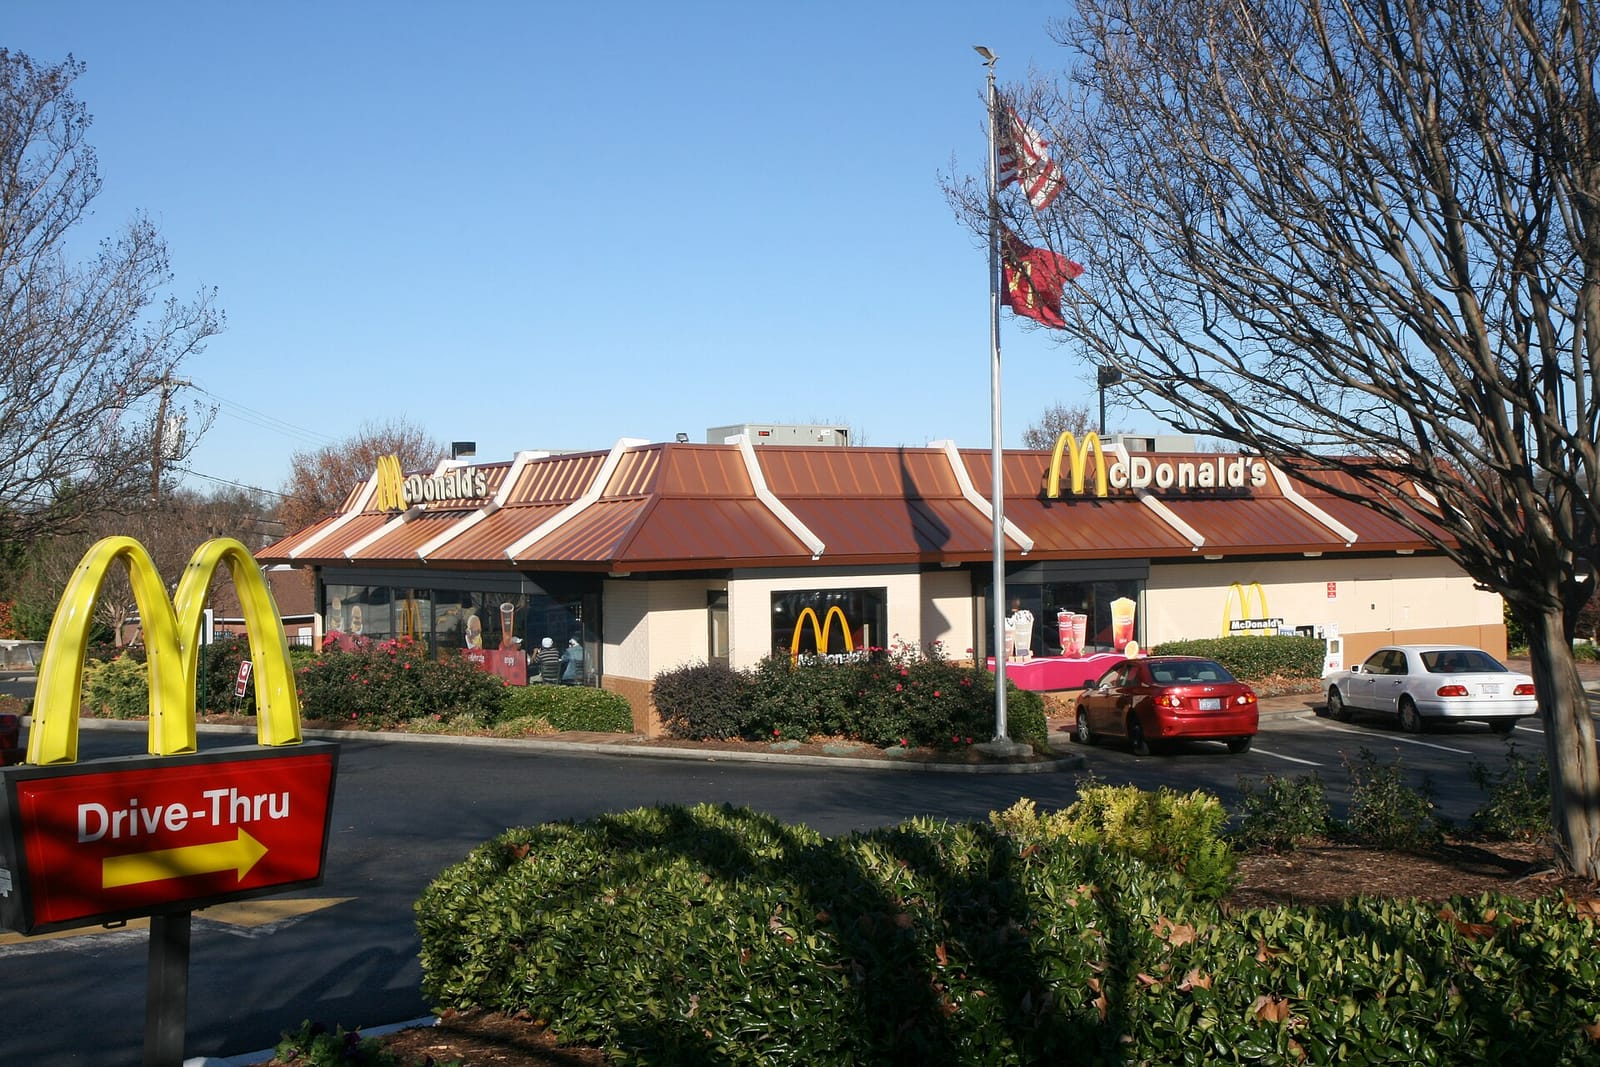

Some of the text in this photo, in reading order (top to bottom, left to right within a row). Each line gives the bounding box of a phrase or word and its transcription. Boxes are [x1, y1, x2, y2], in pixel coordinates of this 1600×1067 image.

[377, 454, 487, 512] McDonald's
[1048, 431, 1267, 498] McDonald's
[77, 787, 290, 843] Drive-Thru
